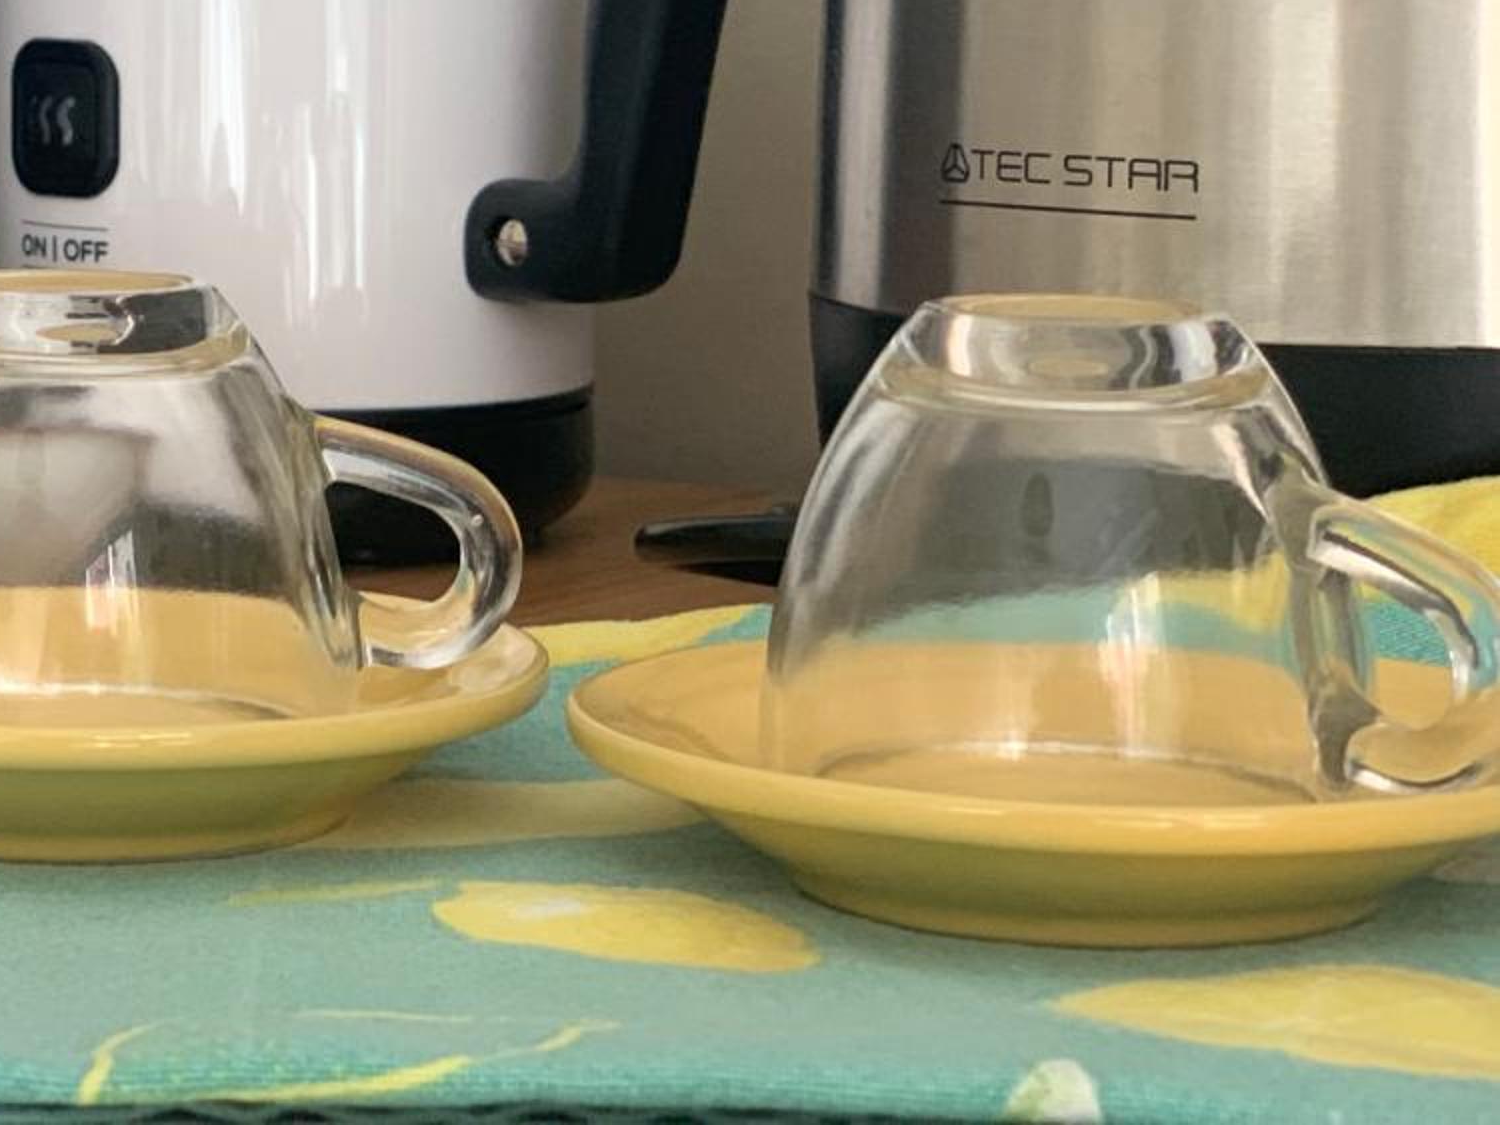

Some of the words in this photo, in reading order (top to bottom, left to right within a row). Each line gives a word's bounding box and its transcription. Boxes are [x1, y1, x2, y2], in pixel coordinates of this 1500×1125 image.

[970, 148, 1052, 185] TEC
[1063, 154, 1199, 193] STAR
[21, 233, 47, 257] ON
[62, 238, 109, 263] OFF
